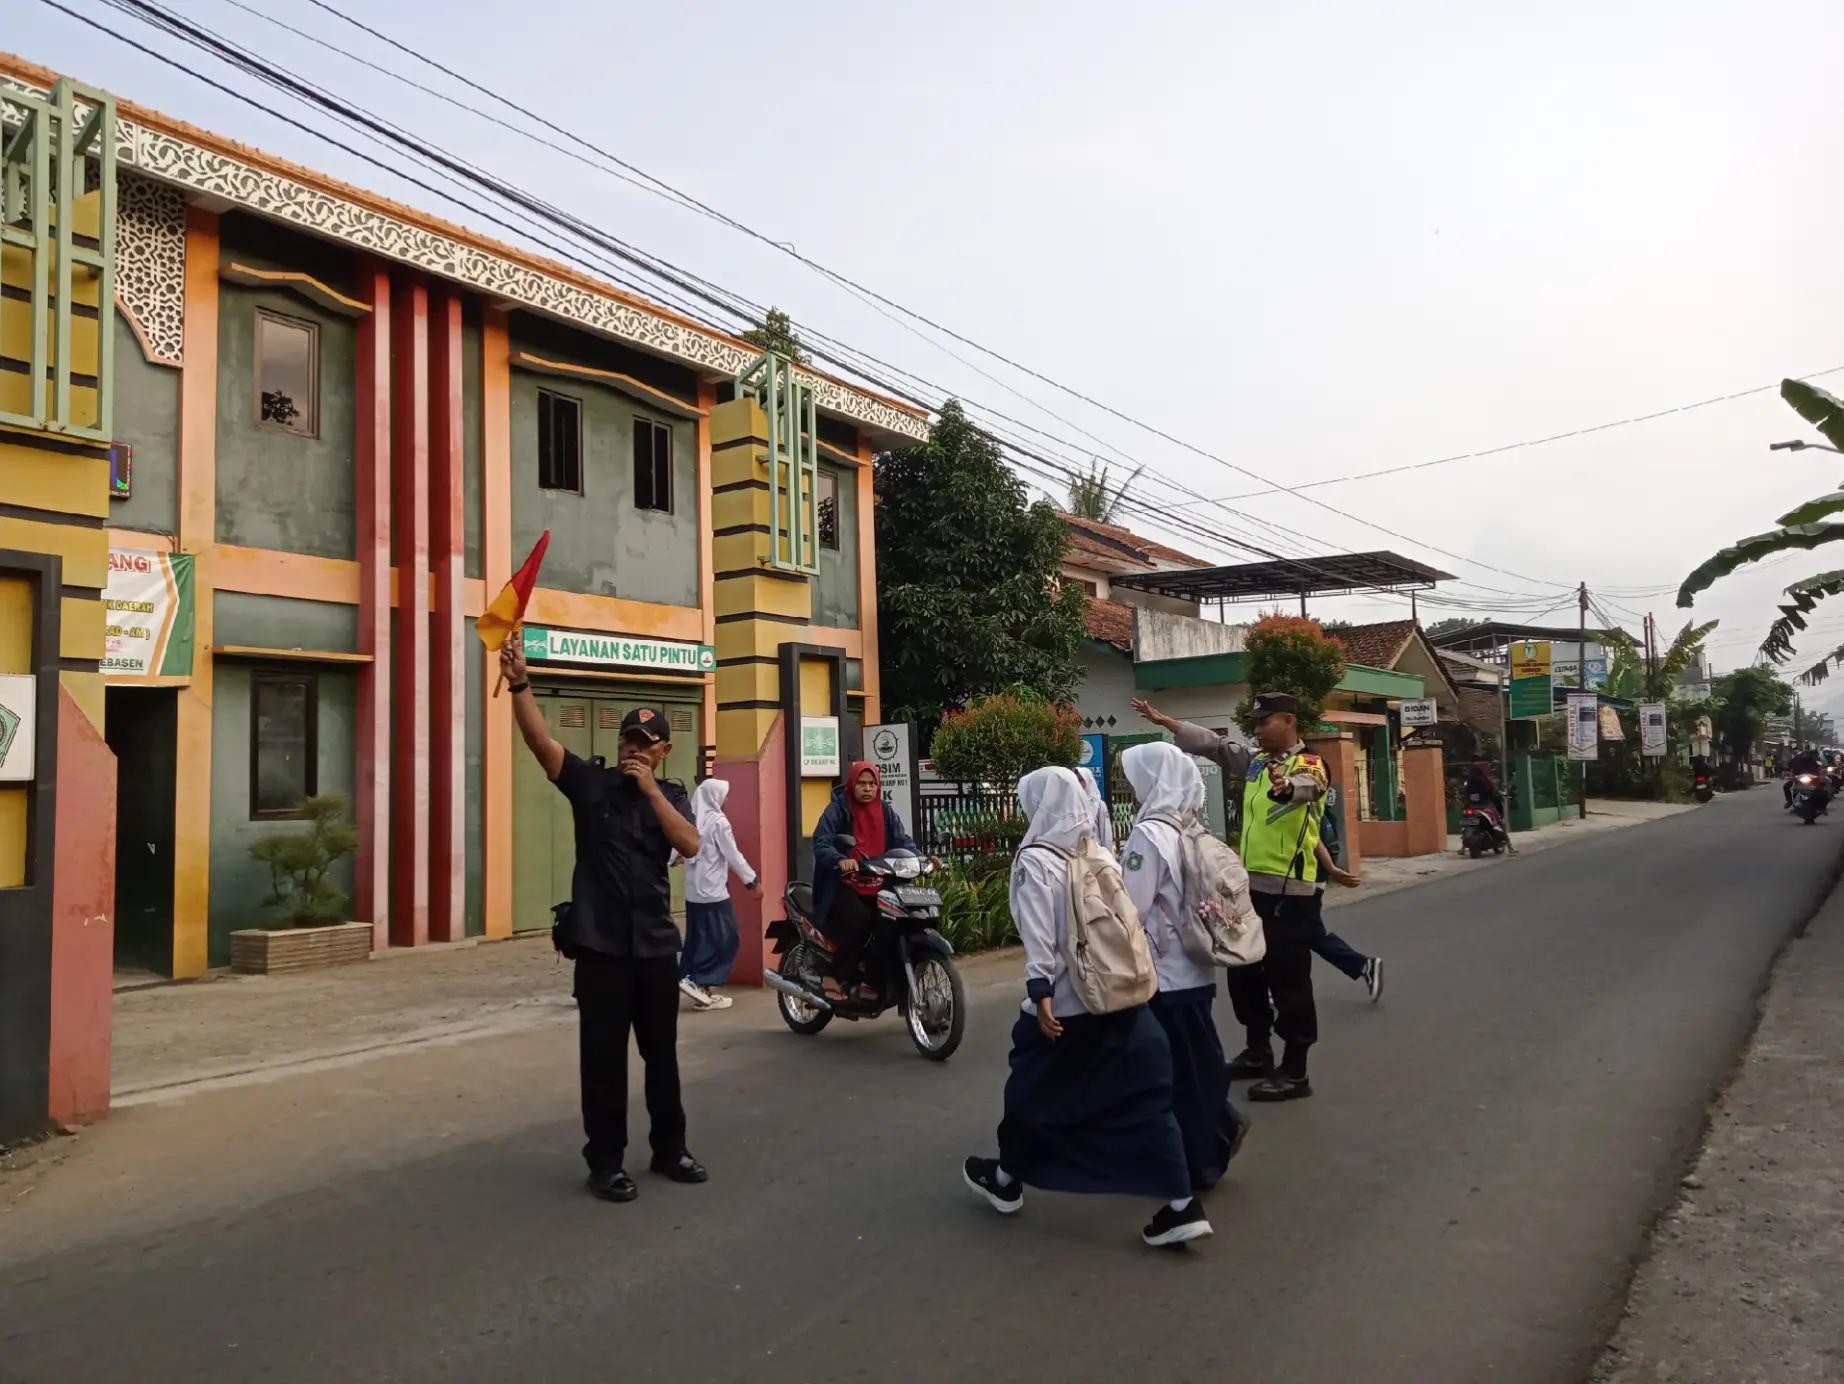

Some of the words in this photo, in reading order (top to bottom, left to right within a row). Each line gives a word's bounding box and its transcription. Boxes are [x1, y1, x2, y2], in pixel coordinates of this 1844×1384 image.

[549, 636, 620, 660] LAYANAN
[622, 643, 657, 663] SATU
[660, 646, 697, 665] PINTU
